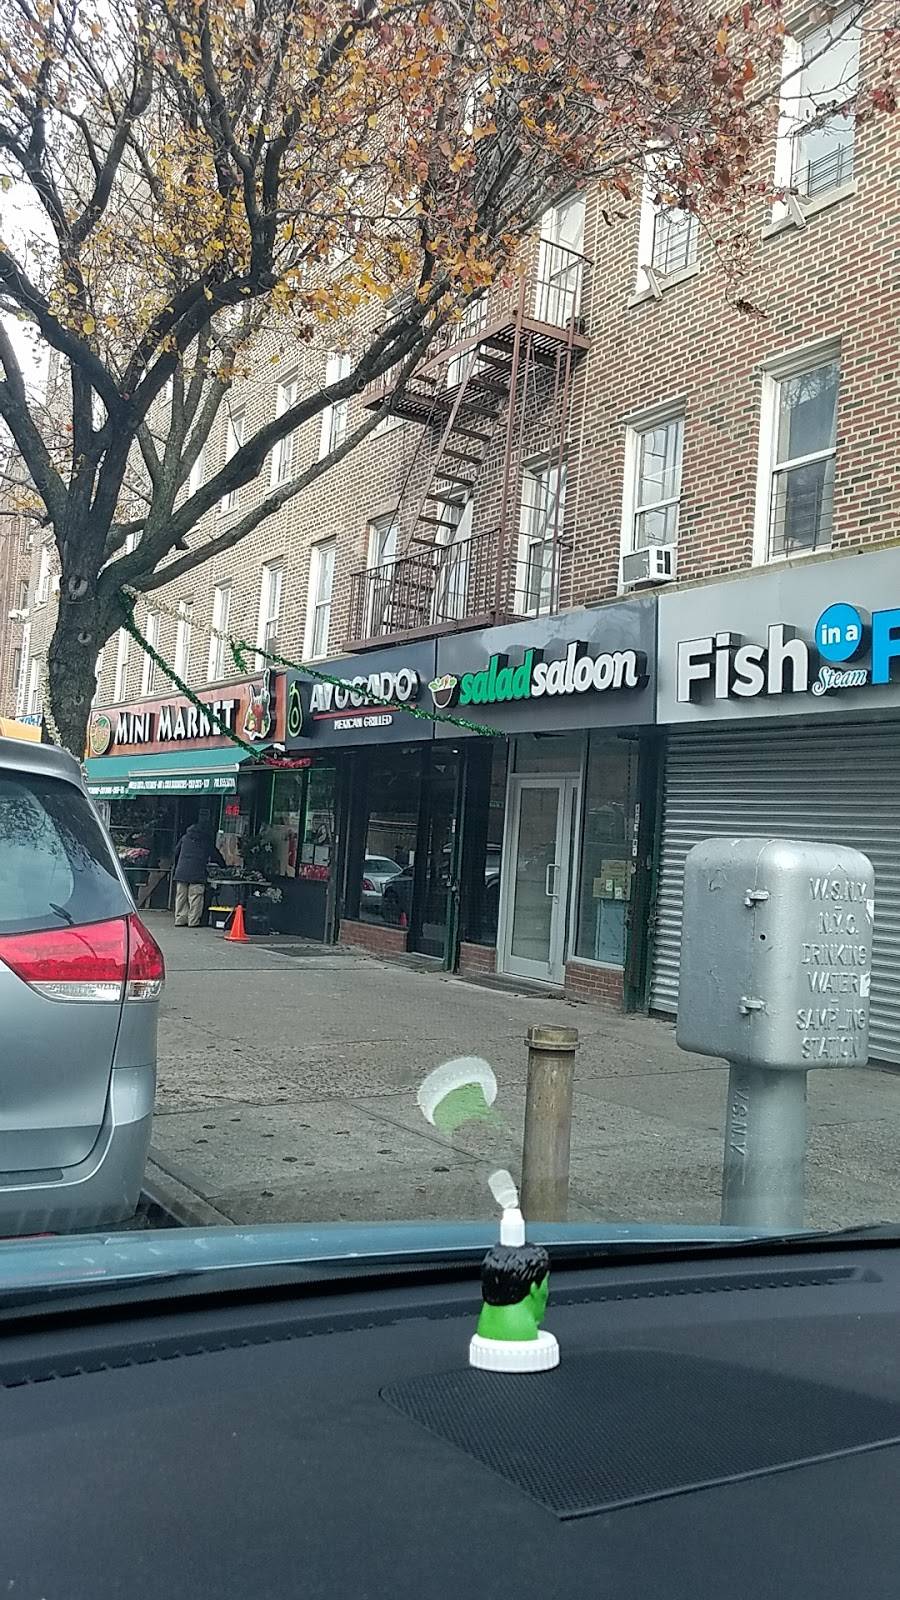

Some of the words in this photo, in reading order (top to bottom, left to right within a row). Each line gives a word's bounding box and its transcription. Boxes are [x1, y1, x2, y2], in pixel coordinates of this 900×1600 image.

[677, 625, 809, 702] Fish
[821, 623, 841, 645] in
[845, 624, 858, 641] a
[309, 668, 417, 713] AVOCADO
[812, 665, 867, 696] Steam
[114, 712, 150, 744] MINI
[157, 700, 235, 741] MARKET
[801, 943, 867, 966] DRINKING
[807, 971, 858, 994] WATER
[796, 1008, 866, 1031] SAMPLING
[802, 1035, 859, 1059] STATION
